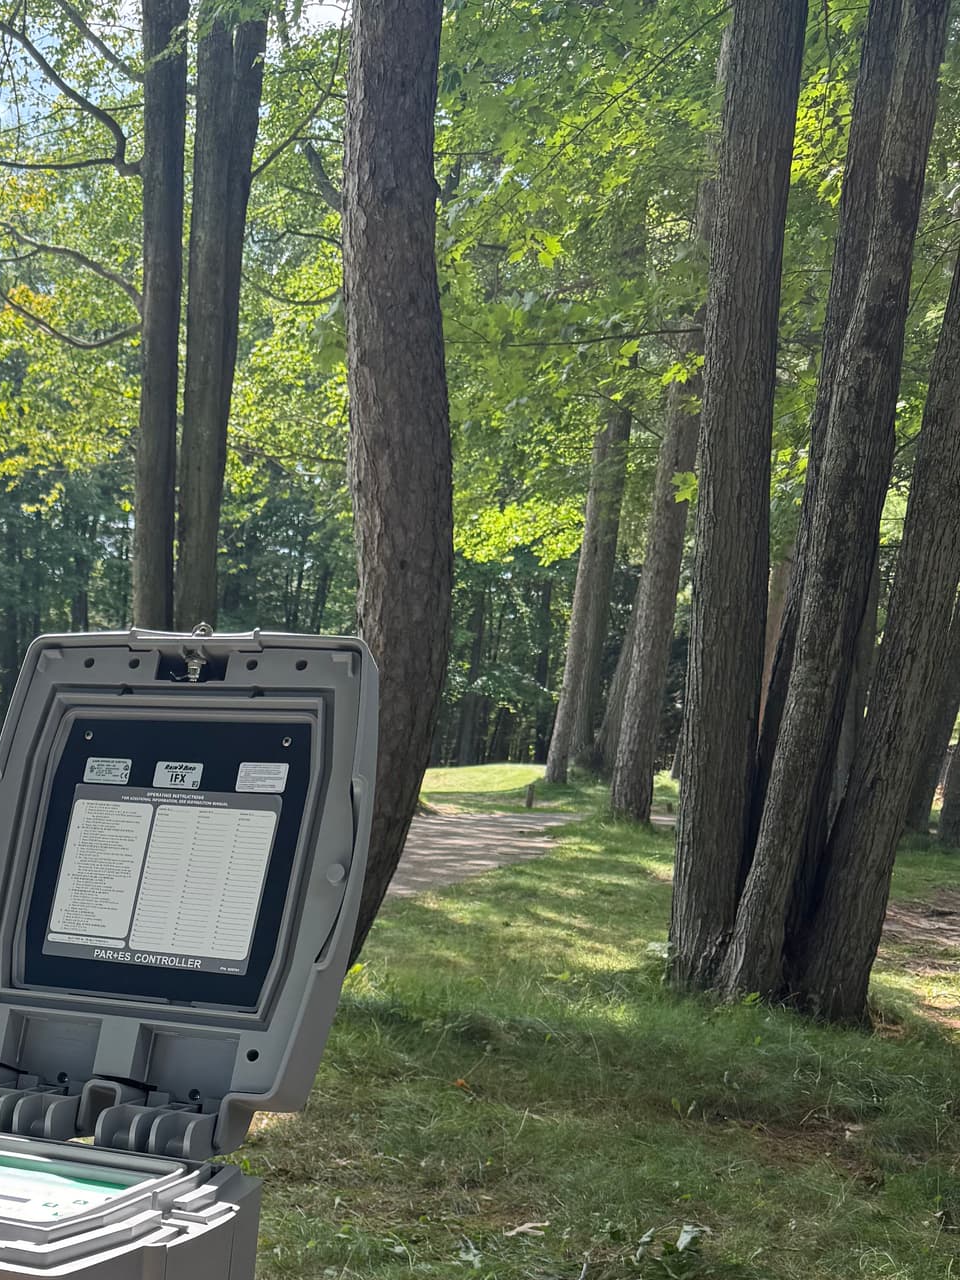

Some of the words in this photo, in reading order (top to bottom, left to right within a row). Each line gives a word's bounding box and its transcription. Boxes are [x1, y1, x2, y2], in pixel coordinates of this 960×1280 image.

[170, 773, 187, 783] IFX
[93, 949, 131, 961] PAR+ES
[134, 953, 202, 969] CONTROLLER
